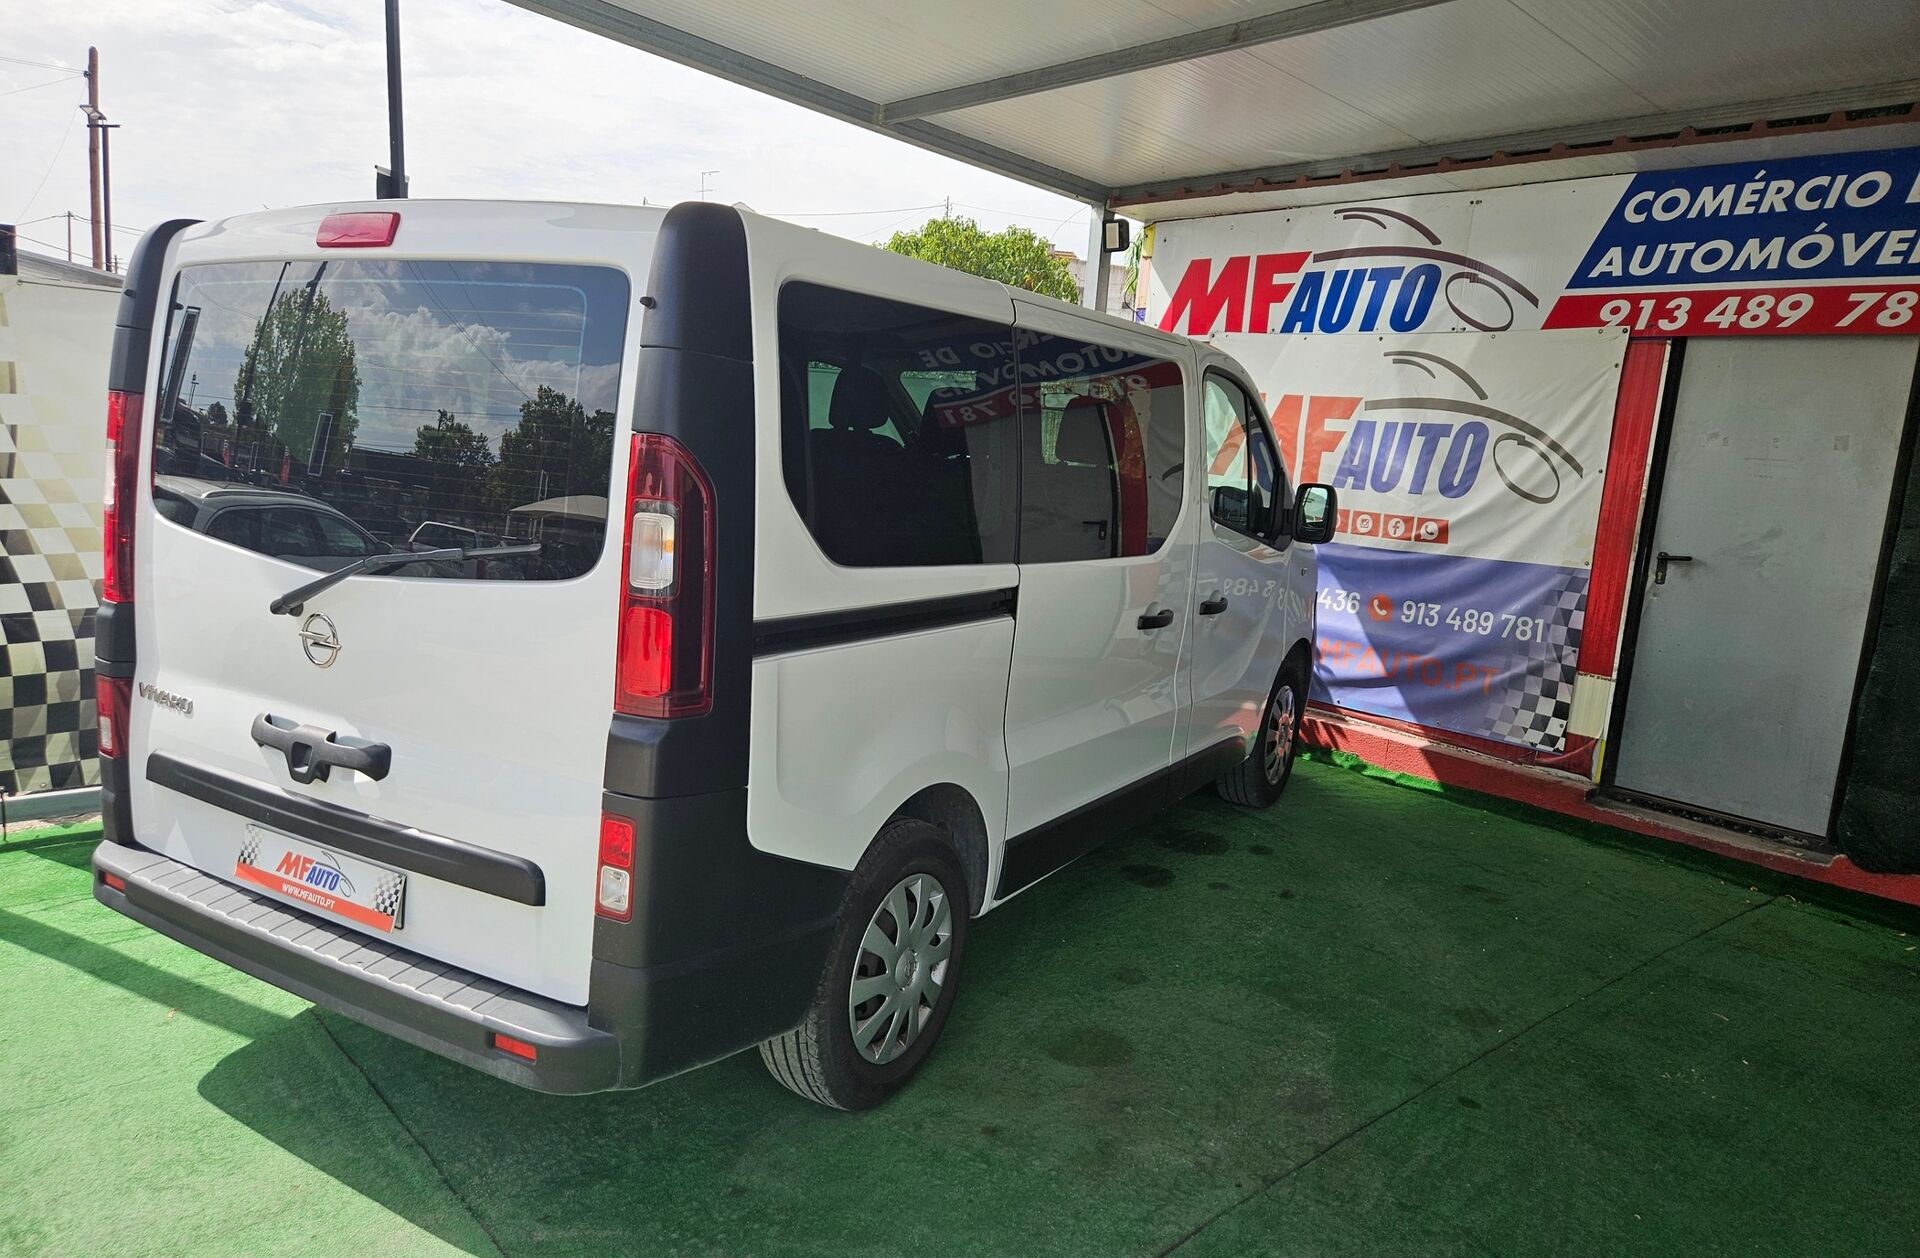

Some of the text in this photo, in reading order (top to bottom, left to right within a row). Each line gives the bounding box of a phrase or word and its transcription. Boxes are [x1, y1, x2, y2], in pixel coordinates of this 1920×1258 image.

[1624, 169, 1892, 223] COMÉRCIO
[1600, 297, 1692, 331] 913
[1704, 293, 1814, 330] 489
[1317, 587, 1361, 614] 436
[1401, 600, 1441, 627] 913
[1446, 607, 1494, 635] 489
[1501, 613, 1545, 643] 781
[282, 883, 336, 910] WWW.MFAUTO.PT
